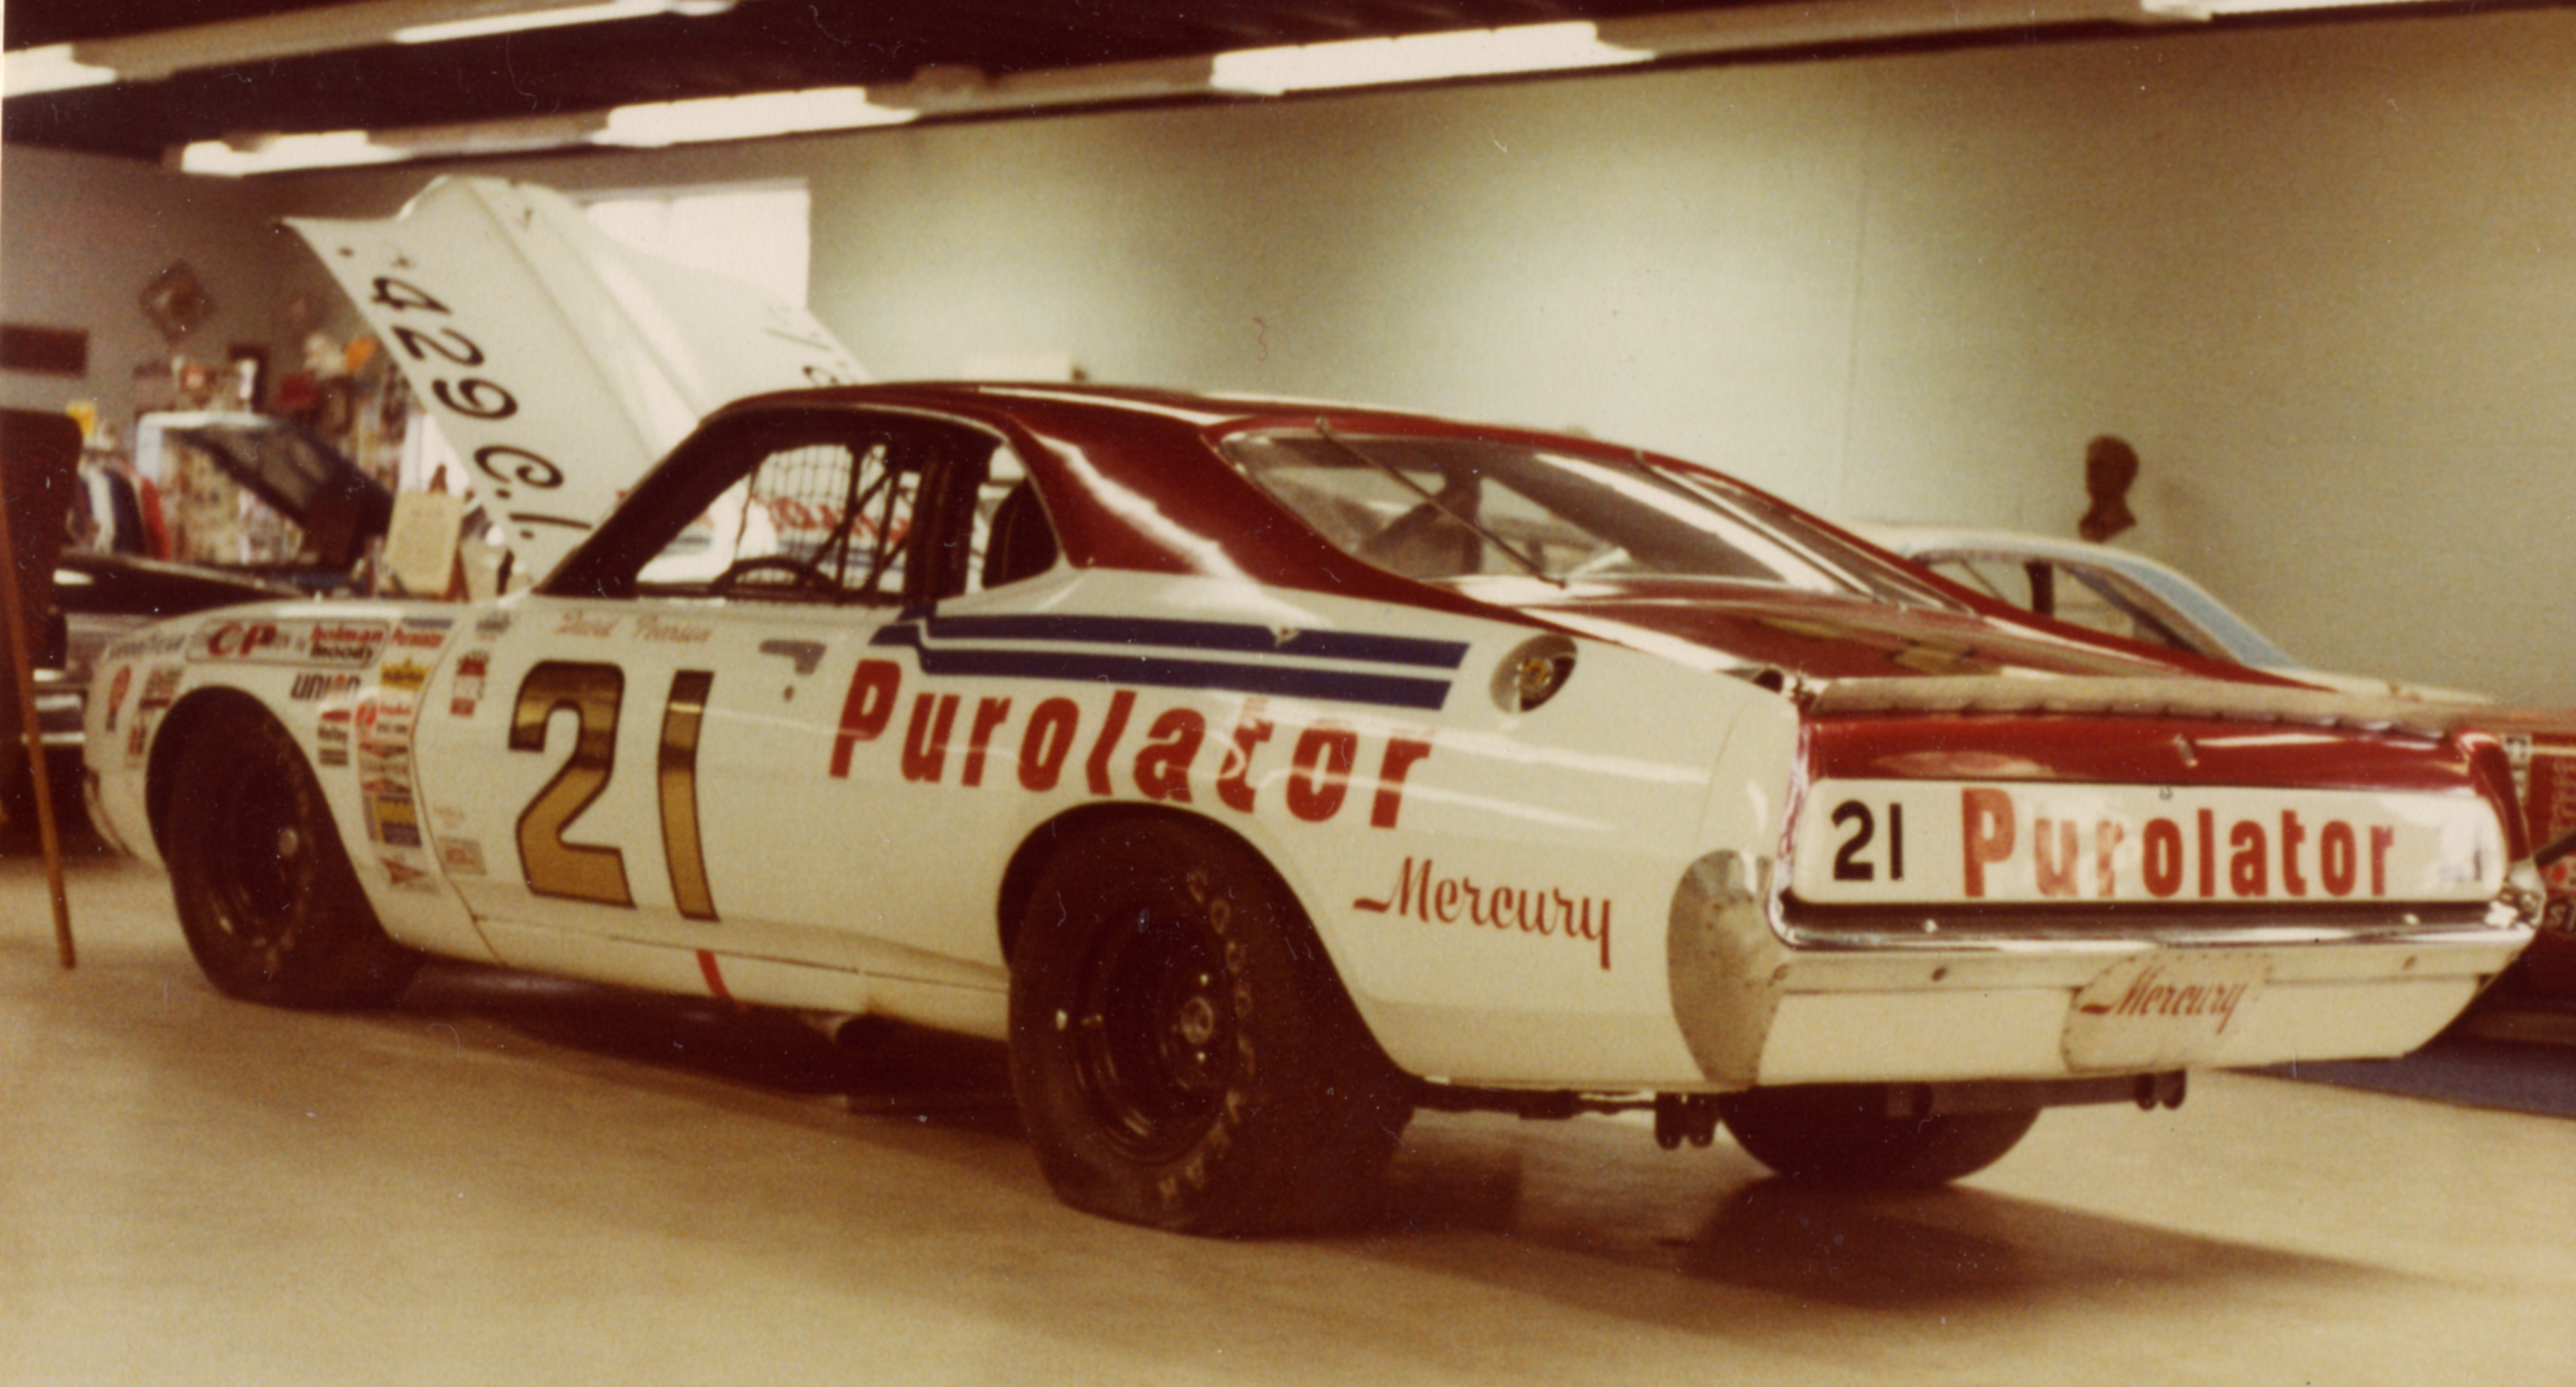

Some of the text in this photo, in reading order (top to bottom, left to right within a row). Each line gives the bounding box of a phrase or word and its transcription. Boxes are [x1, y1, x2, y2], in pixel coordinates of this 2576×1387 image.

[371, 275, 518, 420] 429
[507, 660, 721, 923] 21
[829, 658, 1434, 829] Purolator
[1830, 800, 1903, 882] 21
[1961, 787, 2394, 898] Purolator
[1353, 856, 1611, 971] Mercury
[2079, 965, 2250, 1035] Mercury
